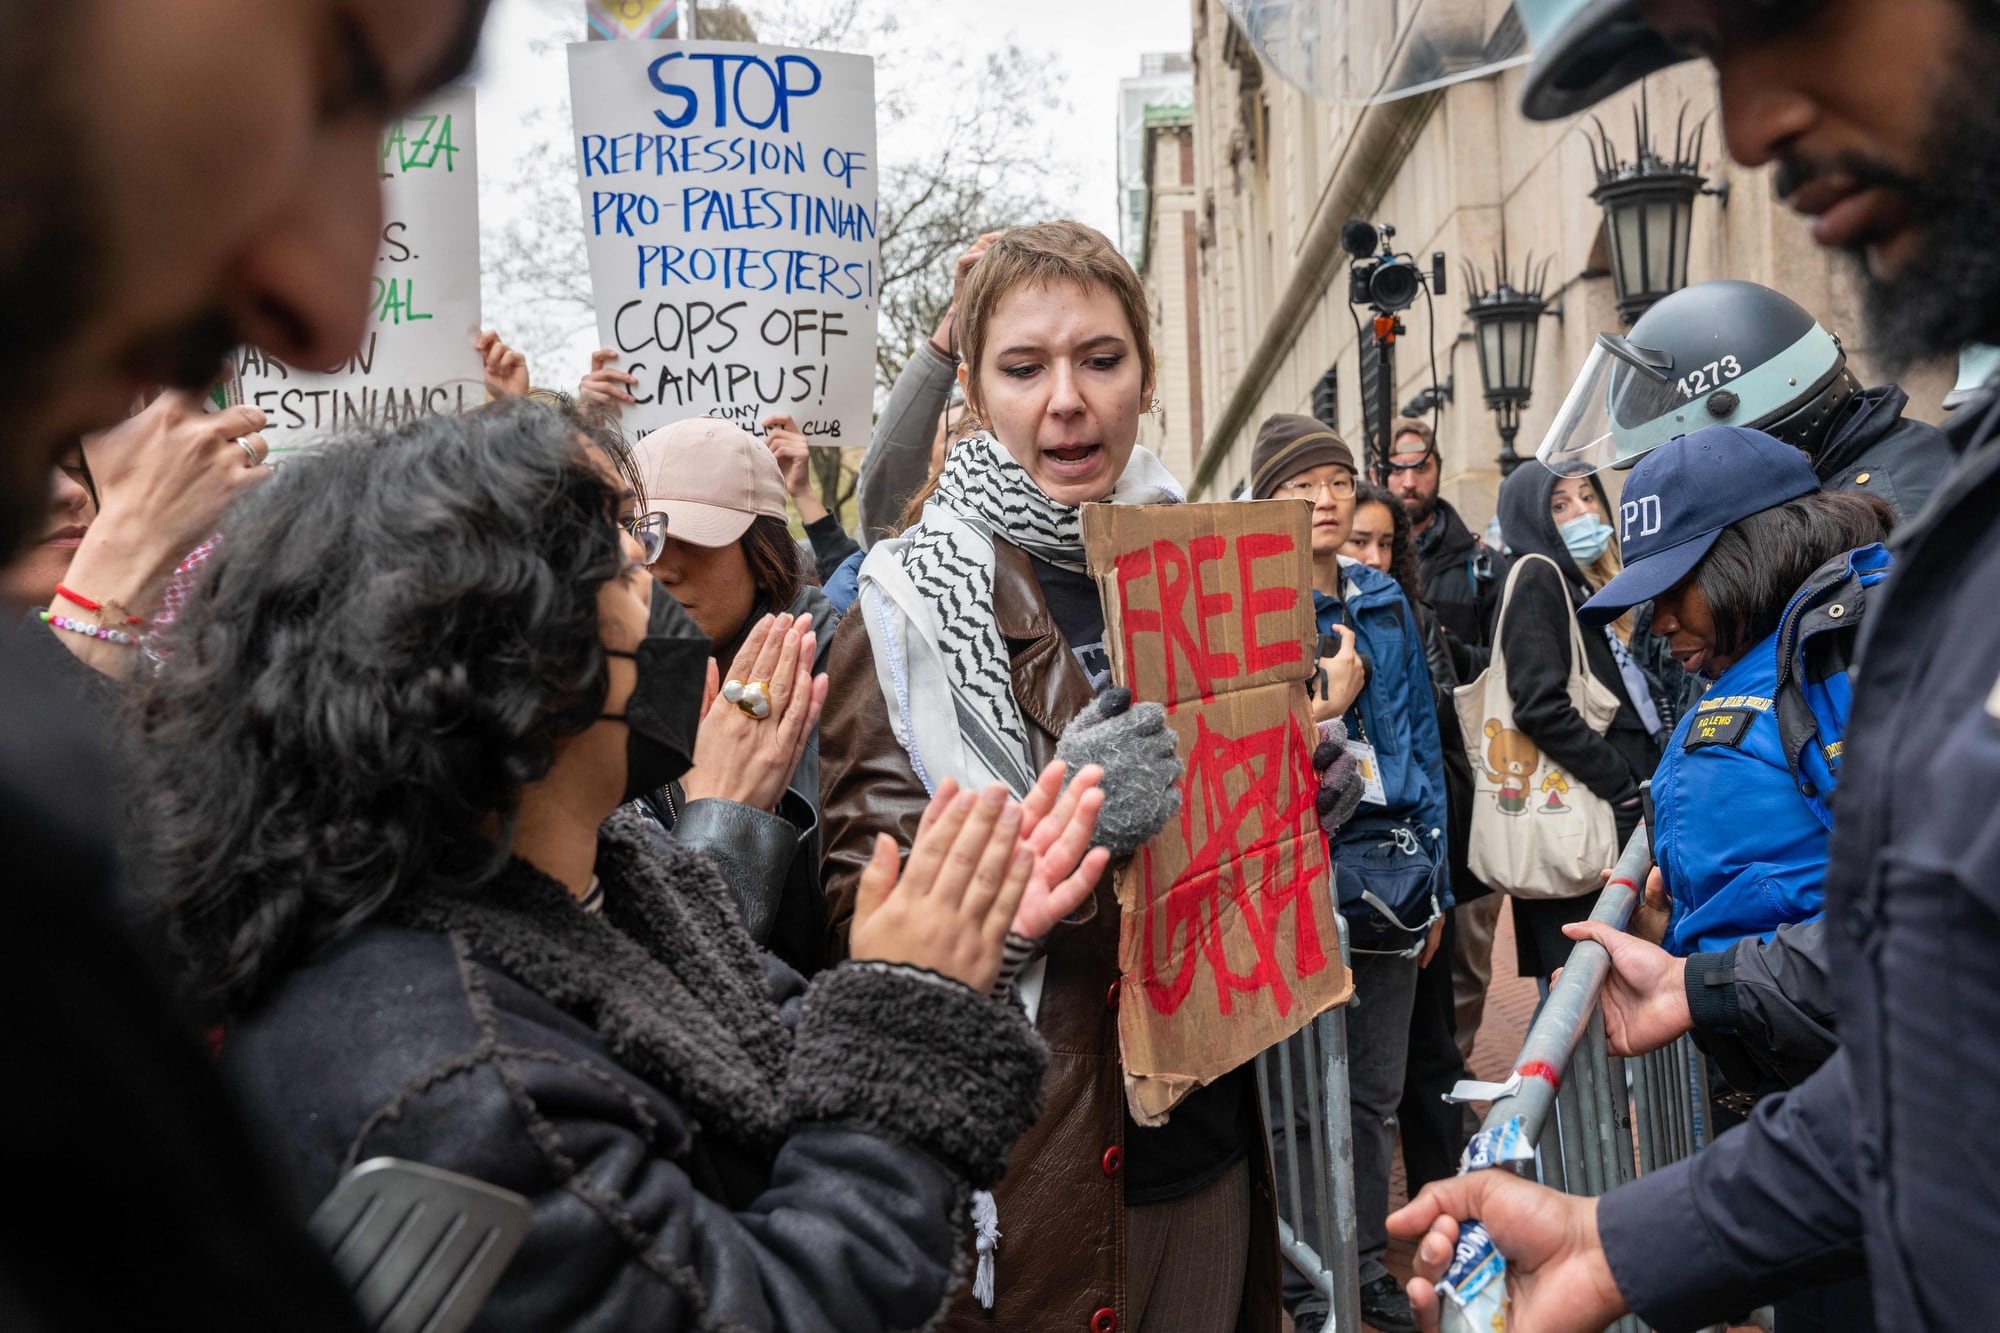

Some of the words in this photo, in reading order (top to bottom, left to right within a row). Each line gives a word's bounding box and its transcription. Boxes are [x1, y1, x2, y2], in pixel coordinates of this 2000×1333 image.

[648, 51, 821, 132] STOP
[381, 113, 460, 174] AZA
[582, 133, 805, 177] REPRESSION
[823, 147, 867, 188] OF
[592, 187, 877, 241] PRO-PALESTINIAN
[638, 245, 873, 309] PROTESTERS!
[615, 300, 747, 359] COPS
[760, 309, 848, 356] OFF
[254, 383, 463, 434] ESTINIANS!
[627, 363, 829, 405] CAMPUS!
[708, 403, 760, 420] CUNY
[802, 419, 841, 437] CLUB
[1620, 494, 1661, 542] PD
[1115, 533, 1304, 714] FREE
